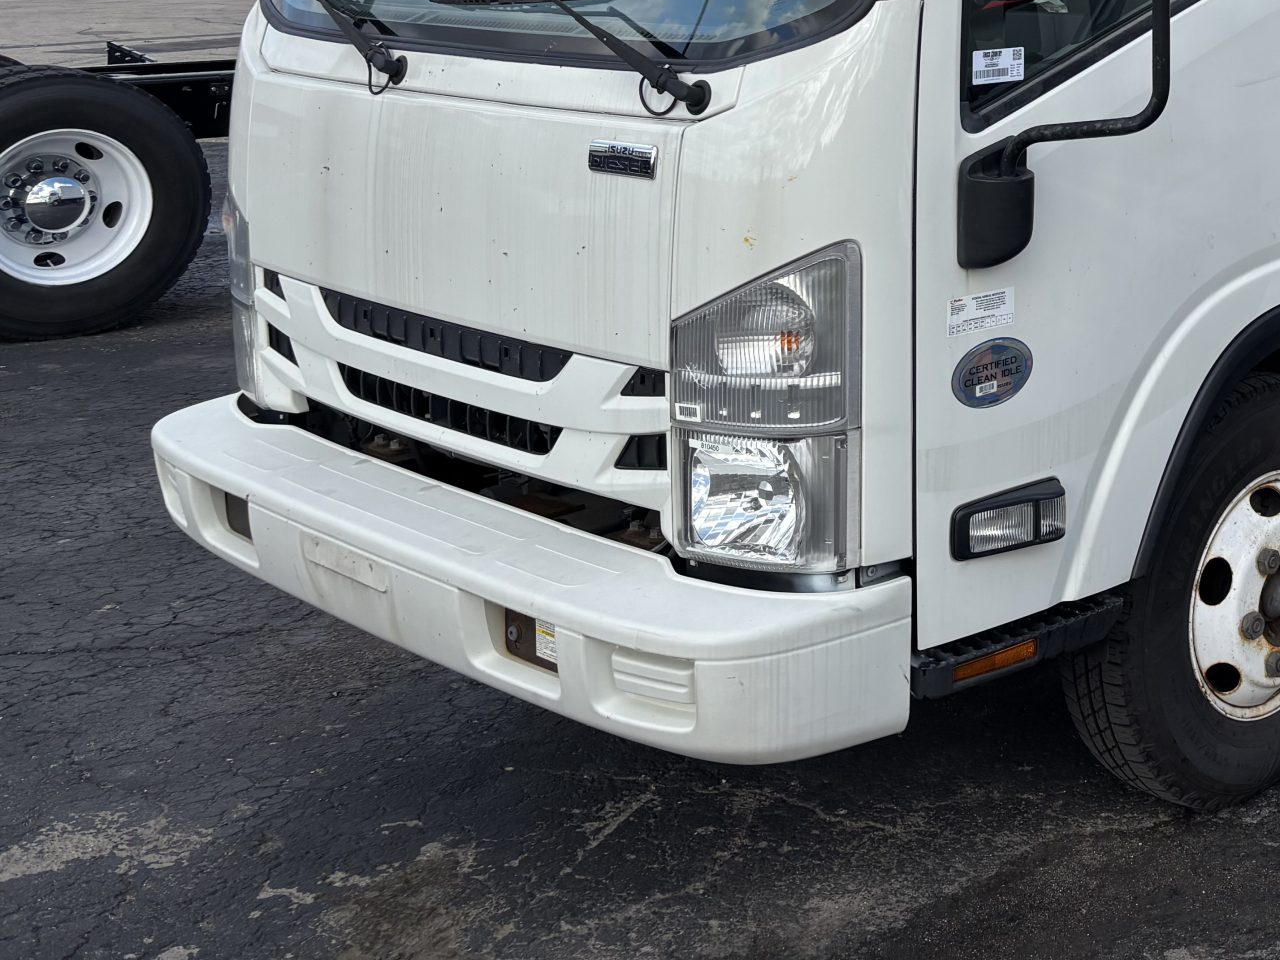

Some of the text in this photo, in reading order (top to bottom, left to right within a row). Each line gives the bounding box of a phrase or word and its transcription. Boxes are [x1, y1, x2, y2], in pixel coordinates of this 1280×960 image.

[608, 145, 634, 155] ISUZU
[969, 356, 1017, 375] CERTIFIED
[964, 365, 1023, 389] CLEAN IDLE
[701, 442, 720, 452] 810450
